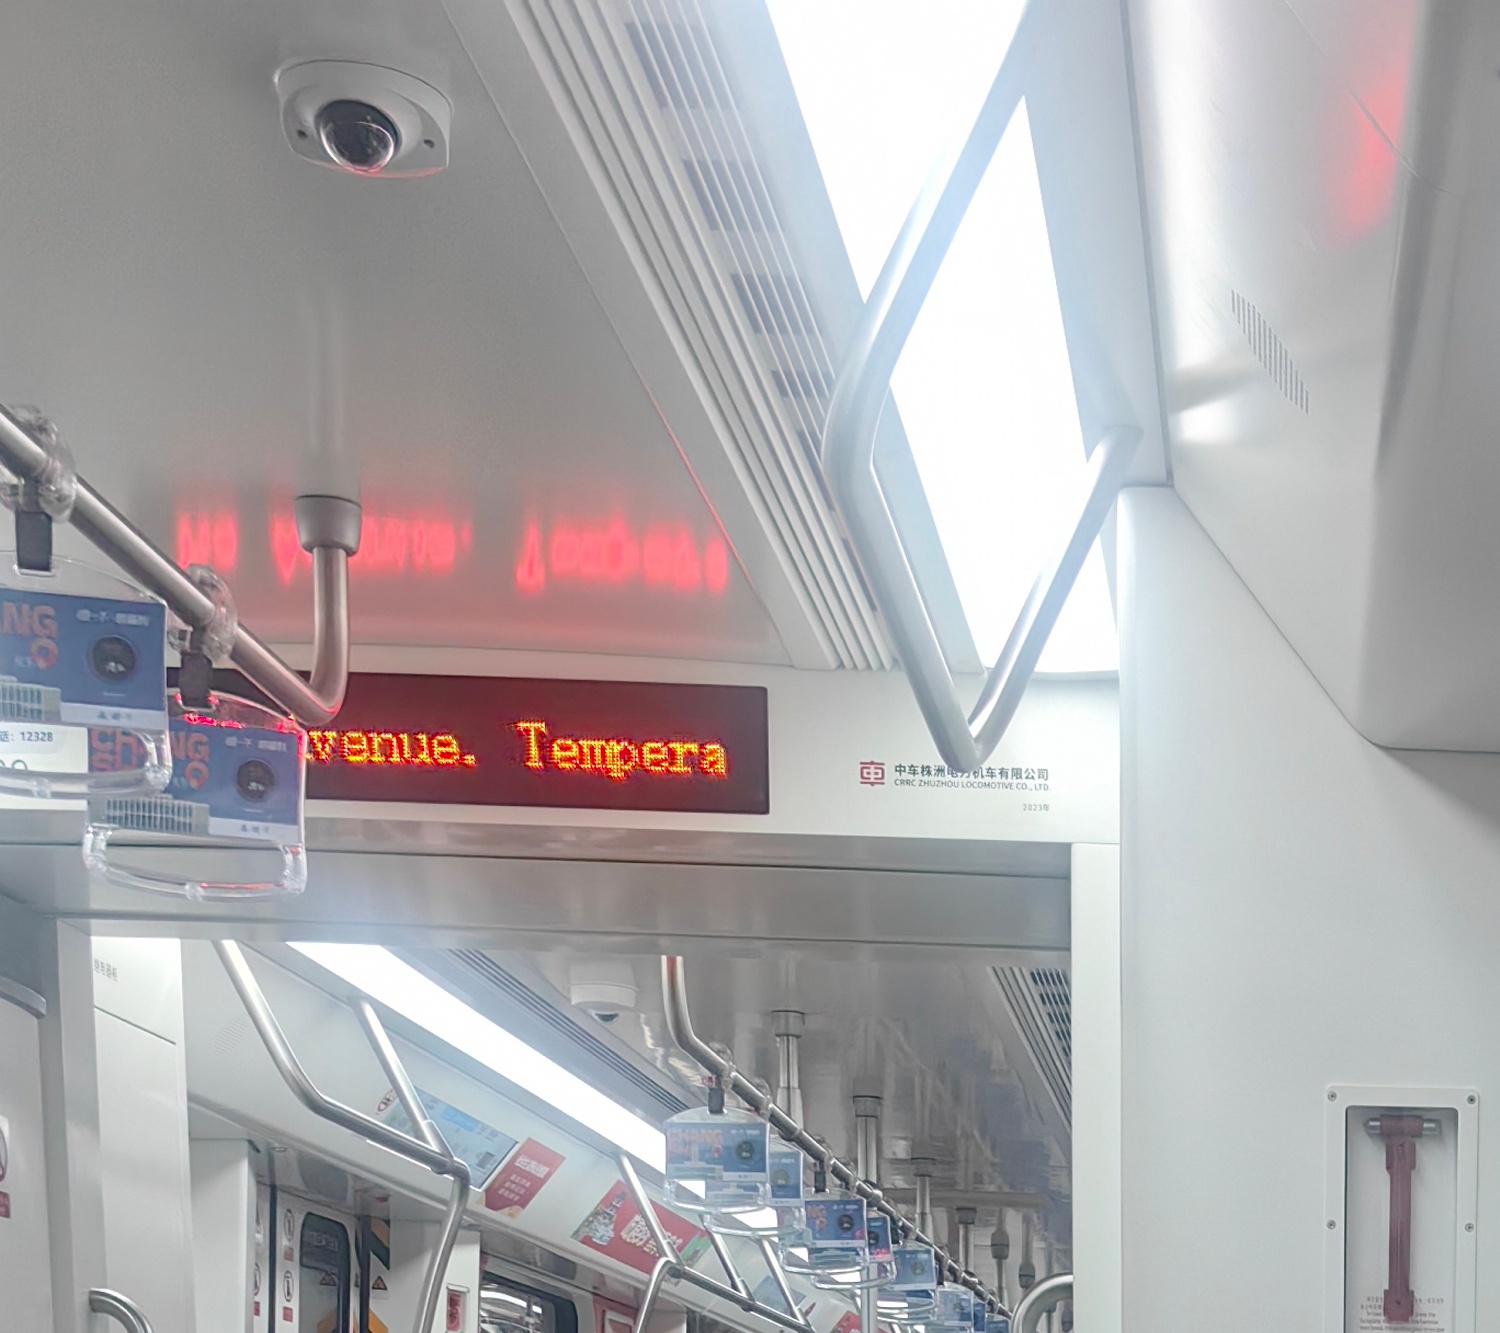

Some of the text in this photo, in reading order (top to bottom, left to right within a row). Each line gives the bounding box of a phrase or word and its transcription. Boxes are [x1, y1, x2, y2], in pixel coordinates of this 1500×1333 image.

[303, 718, 728, 780] venue. Tempera
[894, 779, 916, 787] CRRC
[918, 779, 959, 788] ZHUZHOU
[961, 780, 1014, 790] LOCOMOTIVE
